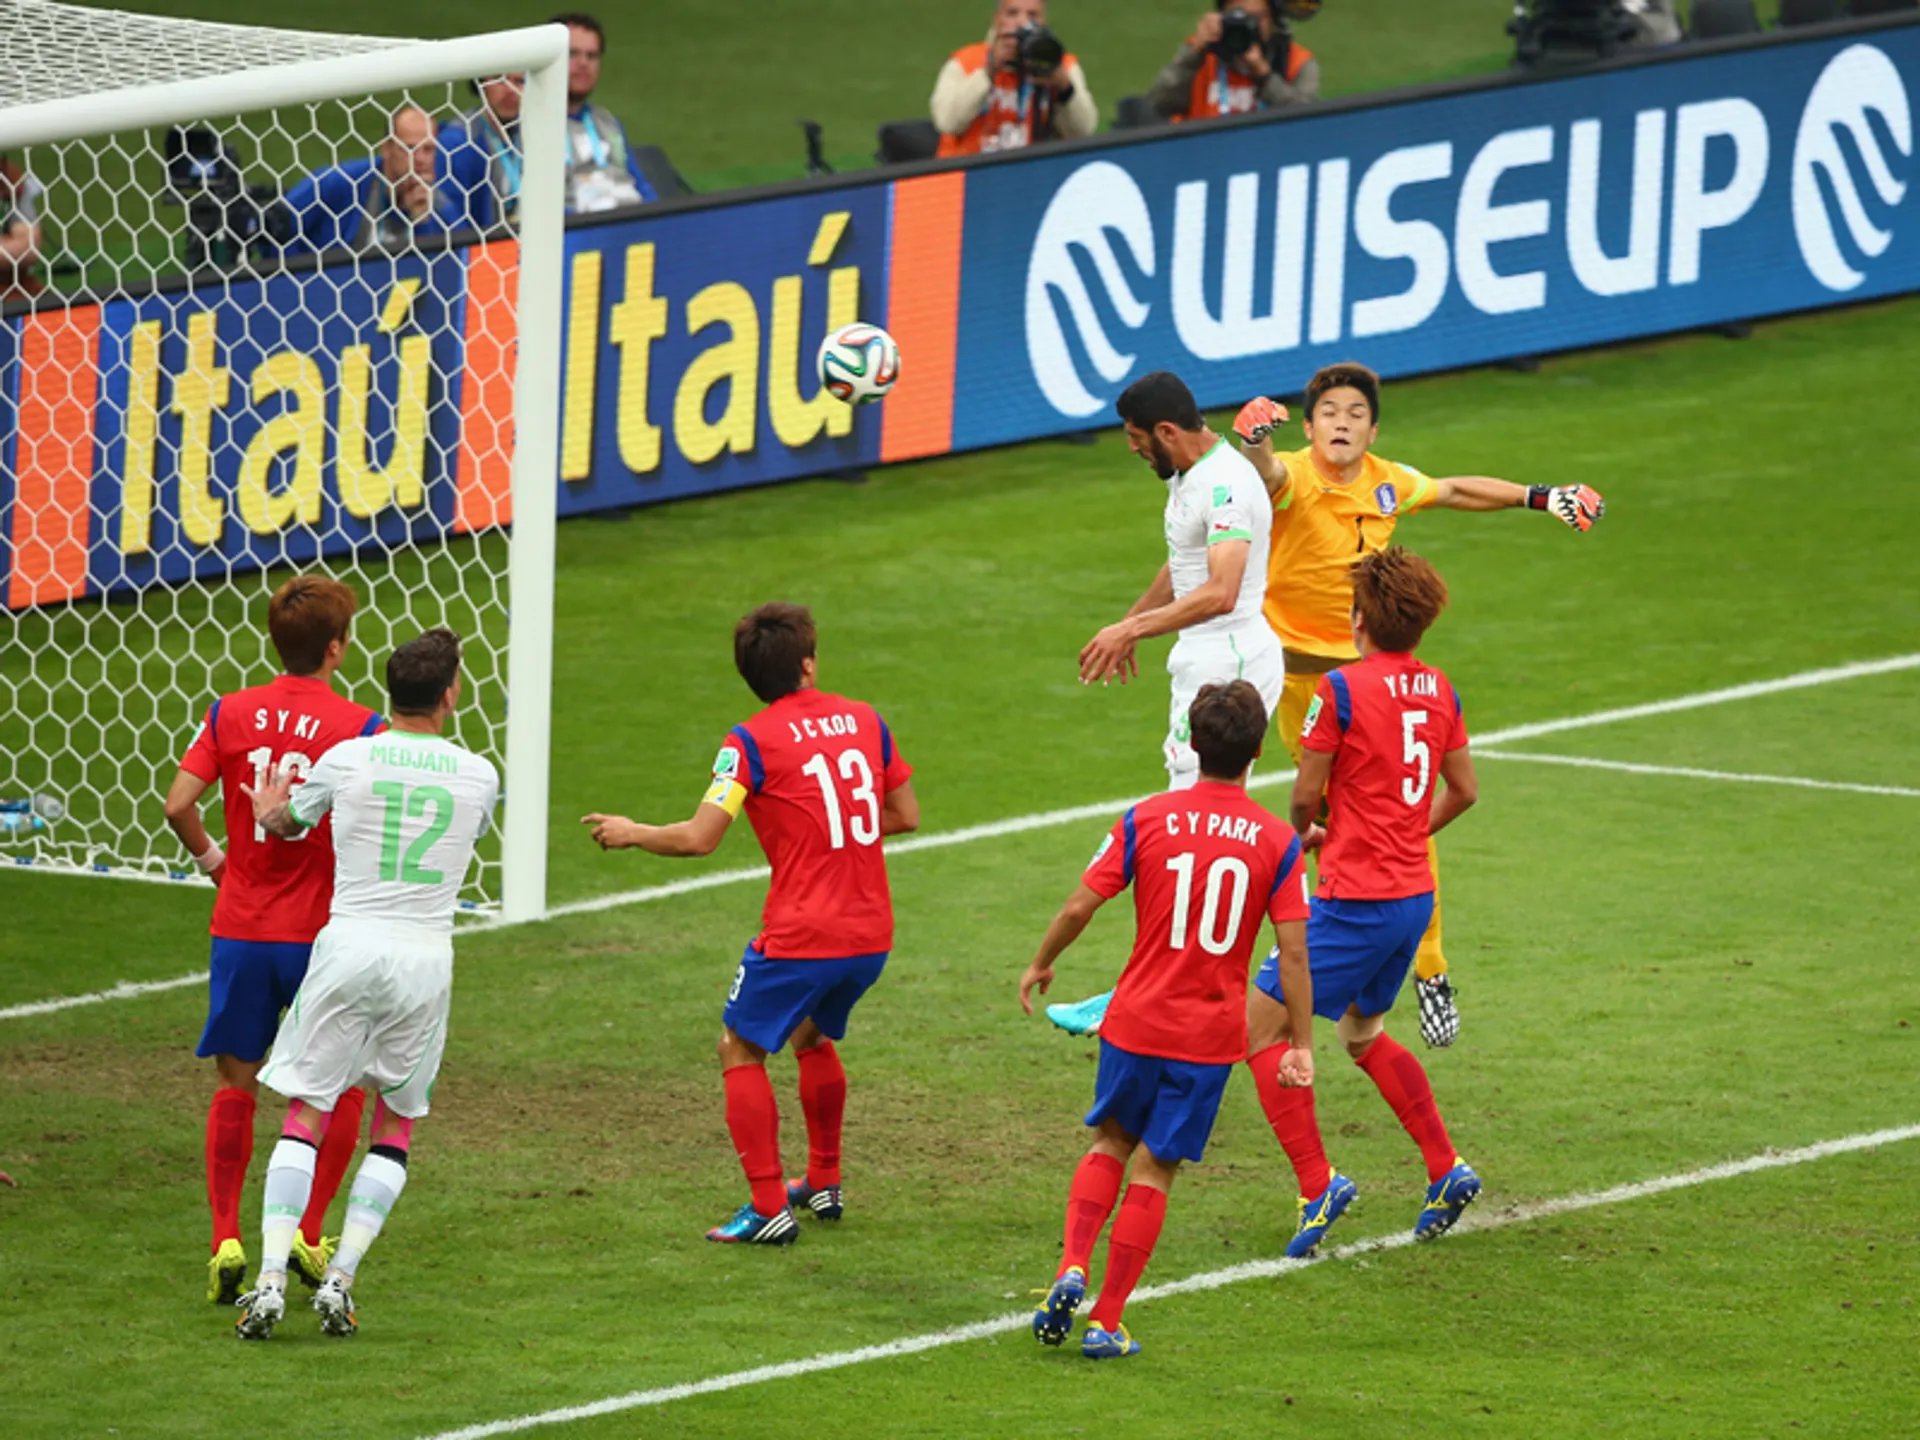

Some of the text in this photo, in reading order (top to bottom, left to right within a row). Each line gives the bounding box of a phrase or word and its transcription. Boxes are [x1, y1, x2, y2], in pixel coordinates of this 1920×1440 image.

[1172, 98, 1769, 361] WISEUP
[561, 212, 859, 481] Itaú
[120, 278, 431, 555] Itaú
[255, 707, 320, 740] S Y KI
[788, 714, 858, 743] J C KOO
[1383, 674, 1397, 698] Y
[369, 744, 458, 774] MEDJANI
[802, 749, 880, 849] 13
[1402, 710, 1430, 806] 5
[372, 780, 455, 884] 12
[1166, 811, 1263, 847] C Y PARK
[1166, 852, 1250, 956] 10
